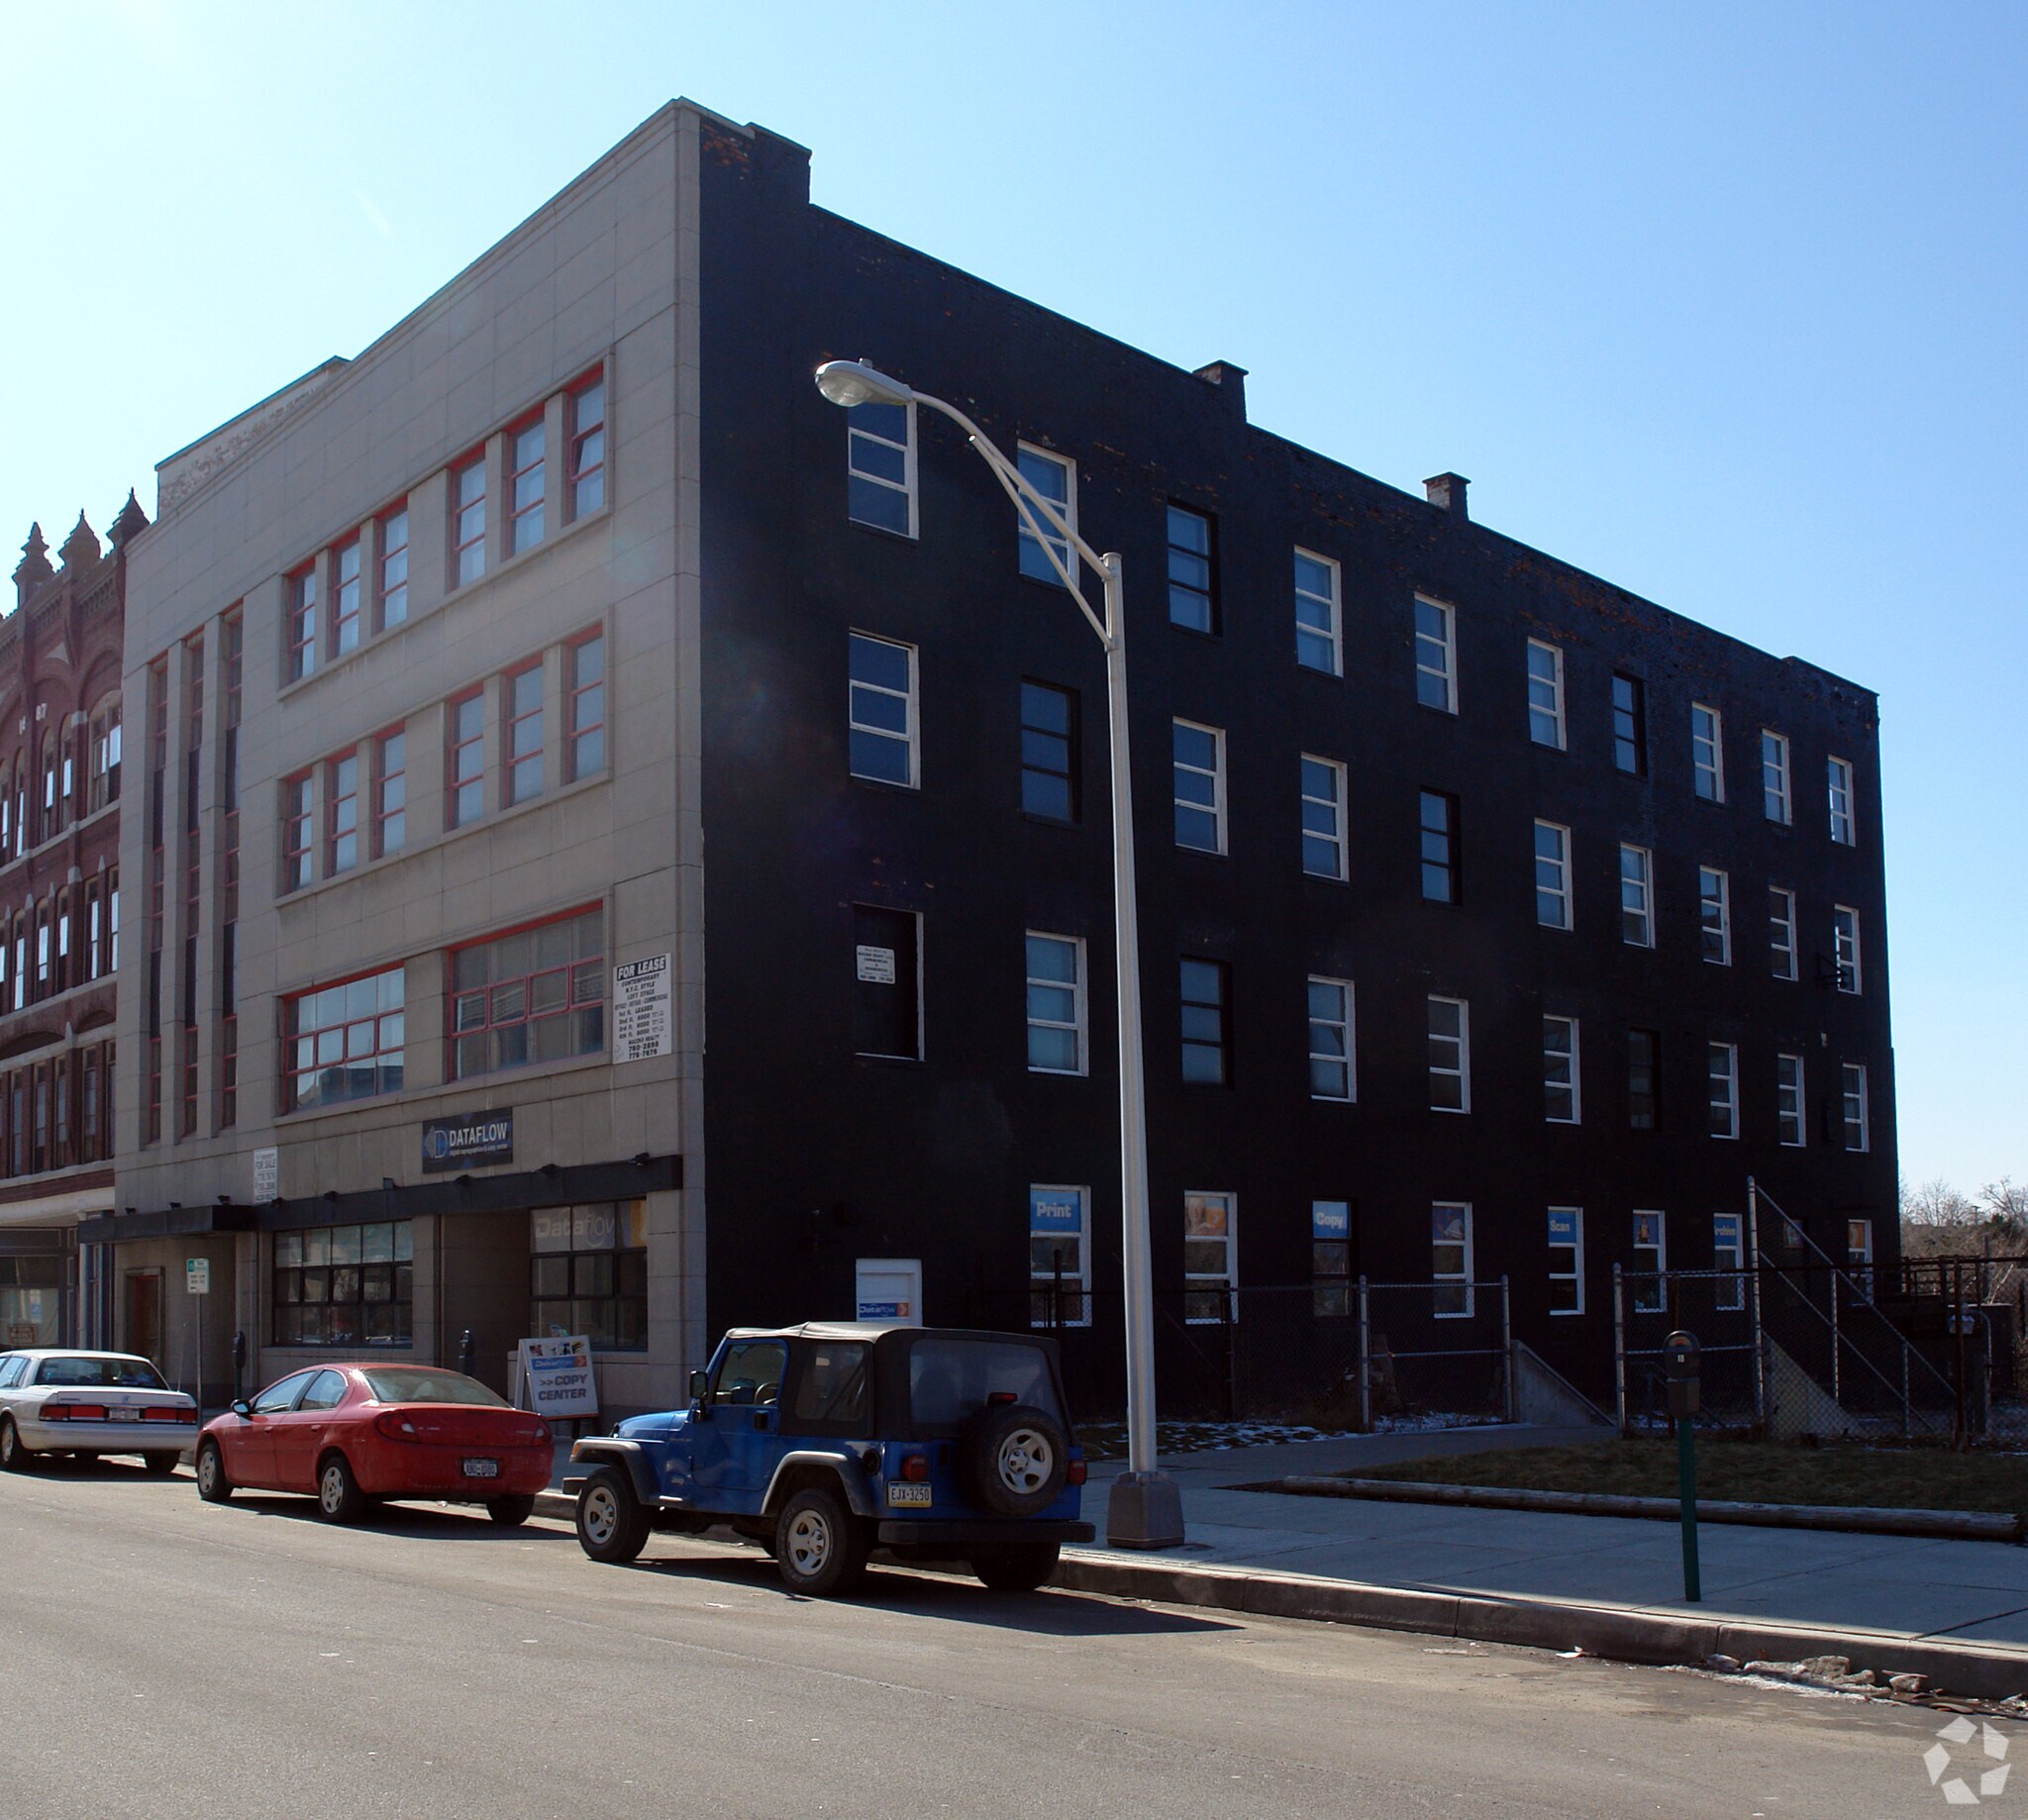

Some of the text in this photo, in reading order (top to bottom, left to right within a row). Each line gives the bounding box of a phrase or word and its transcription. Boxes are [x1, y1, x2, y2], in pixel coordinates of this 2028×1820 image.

[618, 957, 665, 979] FOR LEASE
[450, 1122, 508, 1147] DATAFLOW
[1036, 1201, 1071, 1218] Print
[1316, 1211, 1344, 1230] Copy
[1549, 1219, 1571, 1232] Scan
[555, 1373, 587, 1386] COPY
[538, 1387, 586, 1401] CENTER
[891, 1487, 930, 1501] EJX-3250
